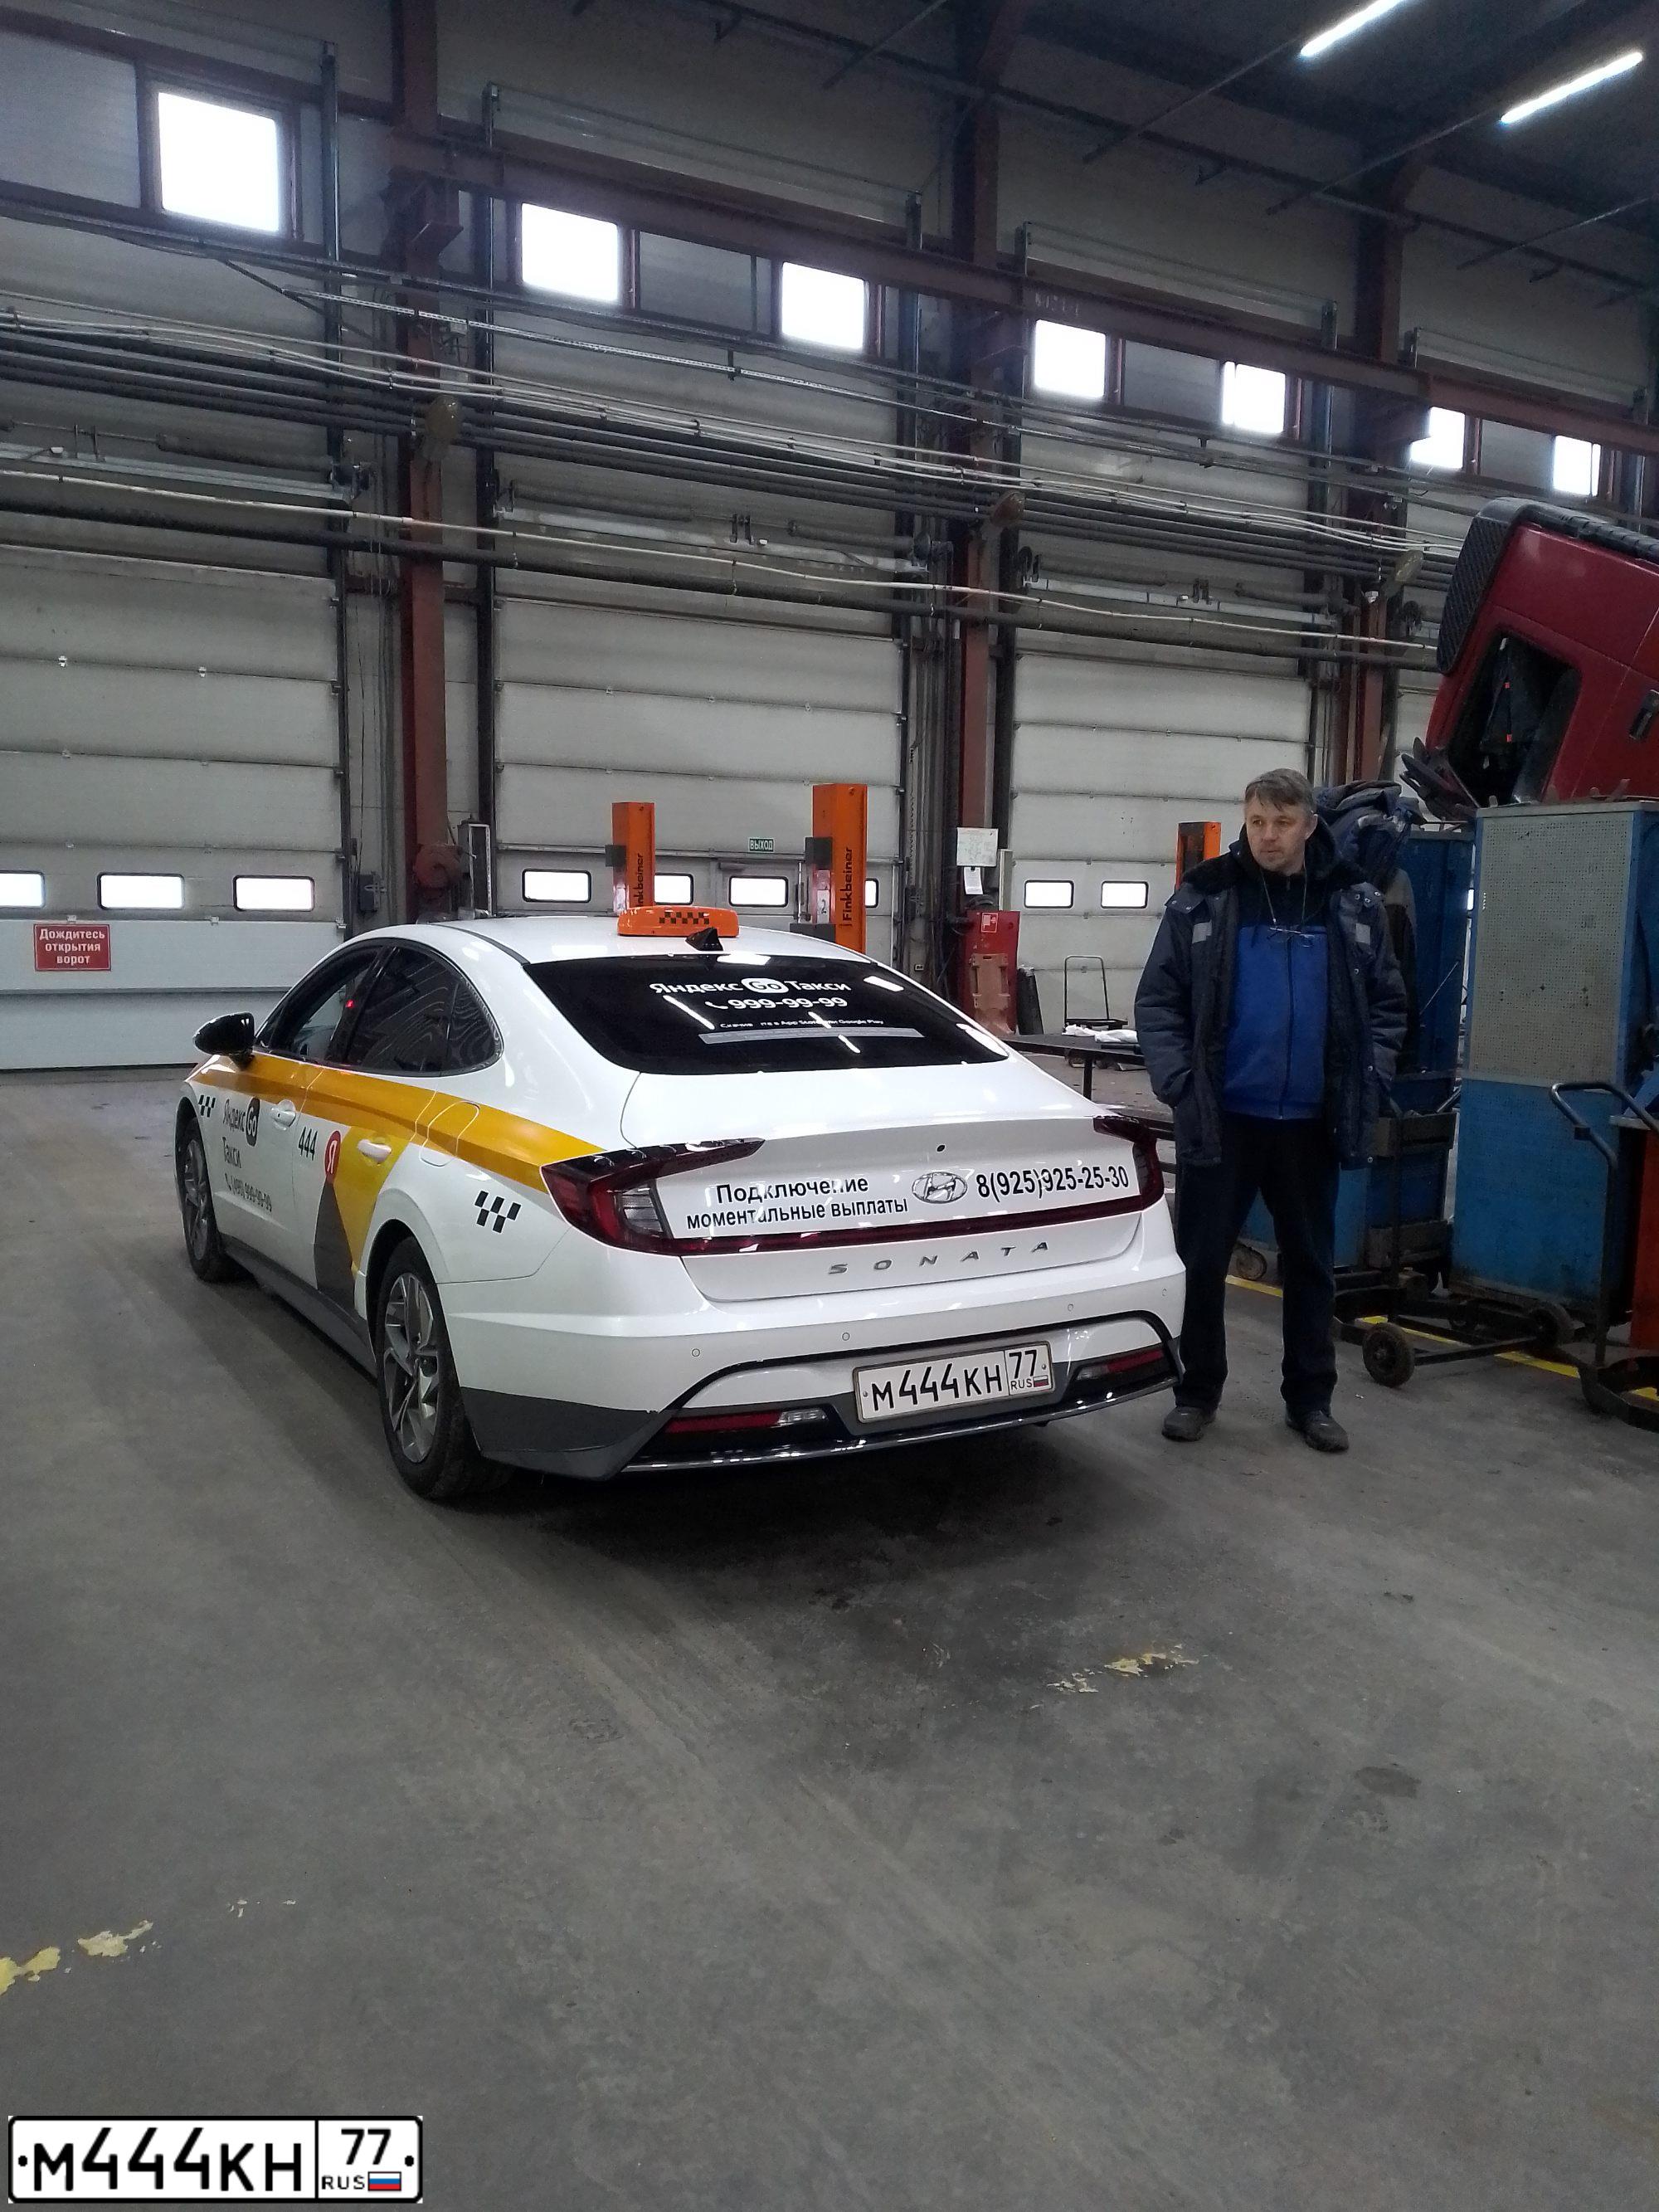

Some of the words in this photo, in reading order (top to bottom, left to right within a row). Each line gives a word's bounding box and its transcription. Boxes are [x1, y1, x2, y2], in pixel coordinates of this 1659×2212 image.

[750, 840, 773, 850] ВЫХОД
[839, 847, 853, 921] Finkbeiner
[39, 928, 105, 941] Дождитесь
[45, 943, 101, 953] открытия
[56, 955, 90, 967] ворот
[649, 982, 744, 994] Яндекс
[784, 980, 852, 992] Такси
[727, 996, 848, 1010] 999-99-99
[222, 1099, 246, 1133] Яндекс
[221, 1136, 242, 1169] Такси
[298, 1126, 318, 1161] 444
[975, 1165, 1129, 1203] 8(925)925-25-30
[687, 1203, 826, 1230] моментальные
[831, 1198, 908, 1218] выплаты
[829, 1241, 1048, 1274] SONATA
[1008, 1349, 1038, 1379] 77
[1010, 1377, 1034, 1391] RUS
